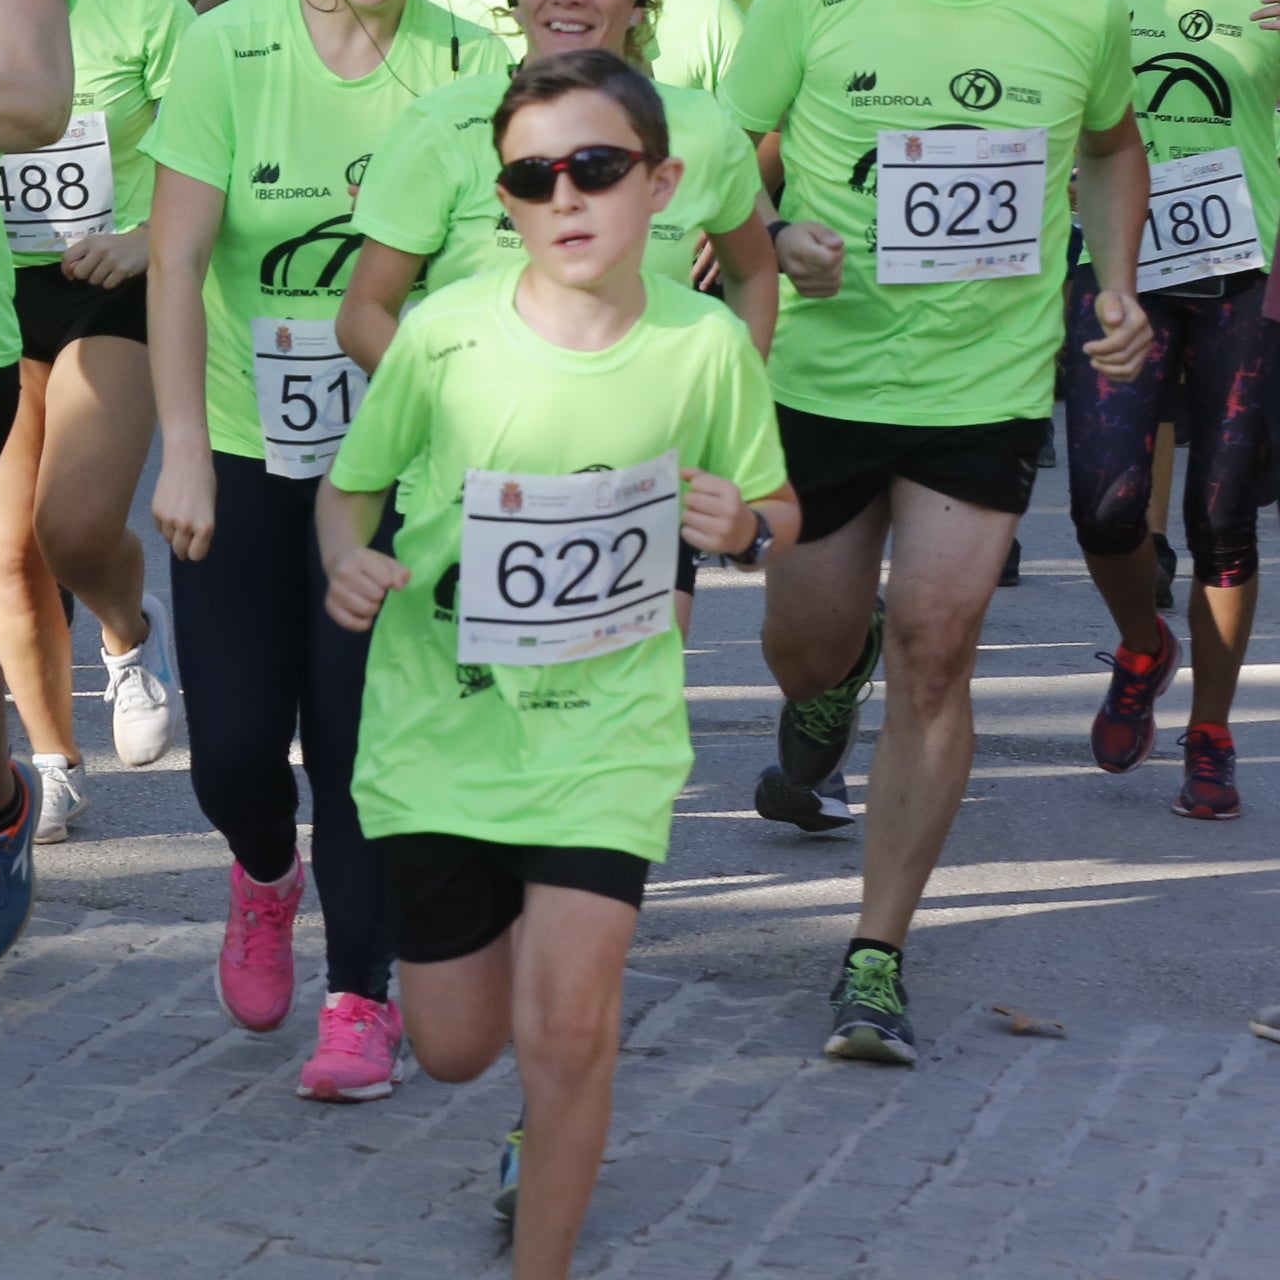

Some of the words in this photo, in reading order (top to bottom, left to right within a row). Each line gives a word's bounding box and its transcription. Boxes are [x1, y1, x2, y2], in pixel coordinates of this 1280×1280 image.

[234, 47, 271, 59] luanvi
[850, 95, 933, 108] IBERDROLA
[1173, 114, 1185, 123] LA
[255, 186, 332, 200] IBERDROLA
[904, 179, 1018, 238] 623
[260, 286, 274, 296] EN
[277, 287, 319, 297] FORMA
[497, 527, 648, 609] 622
